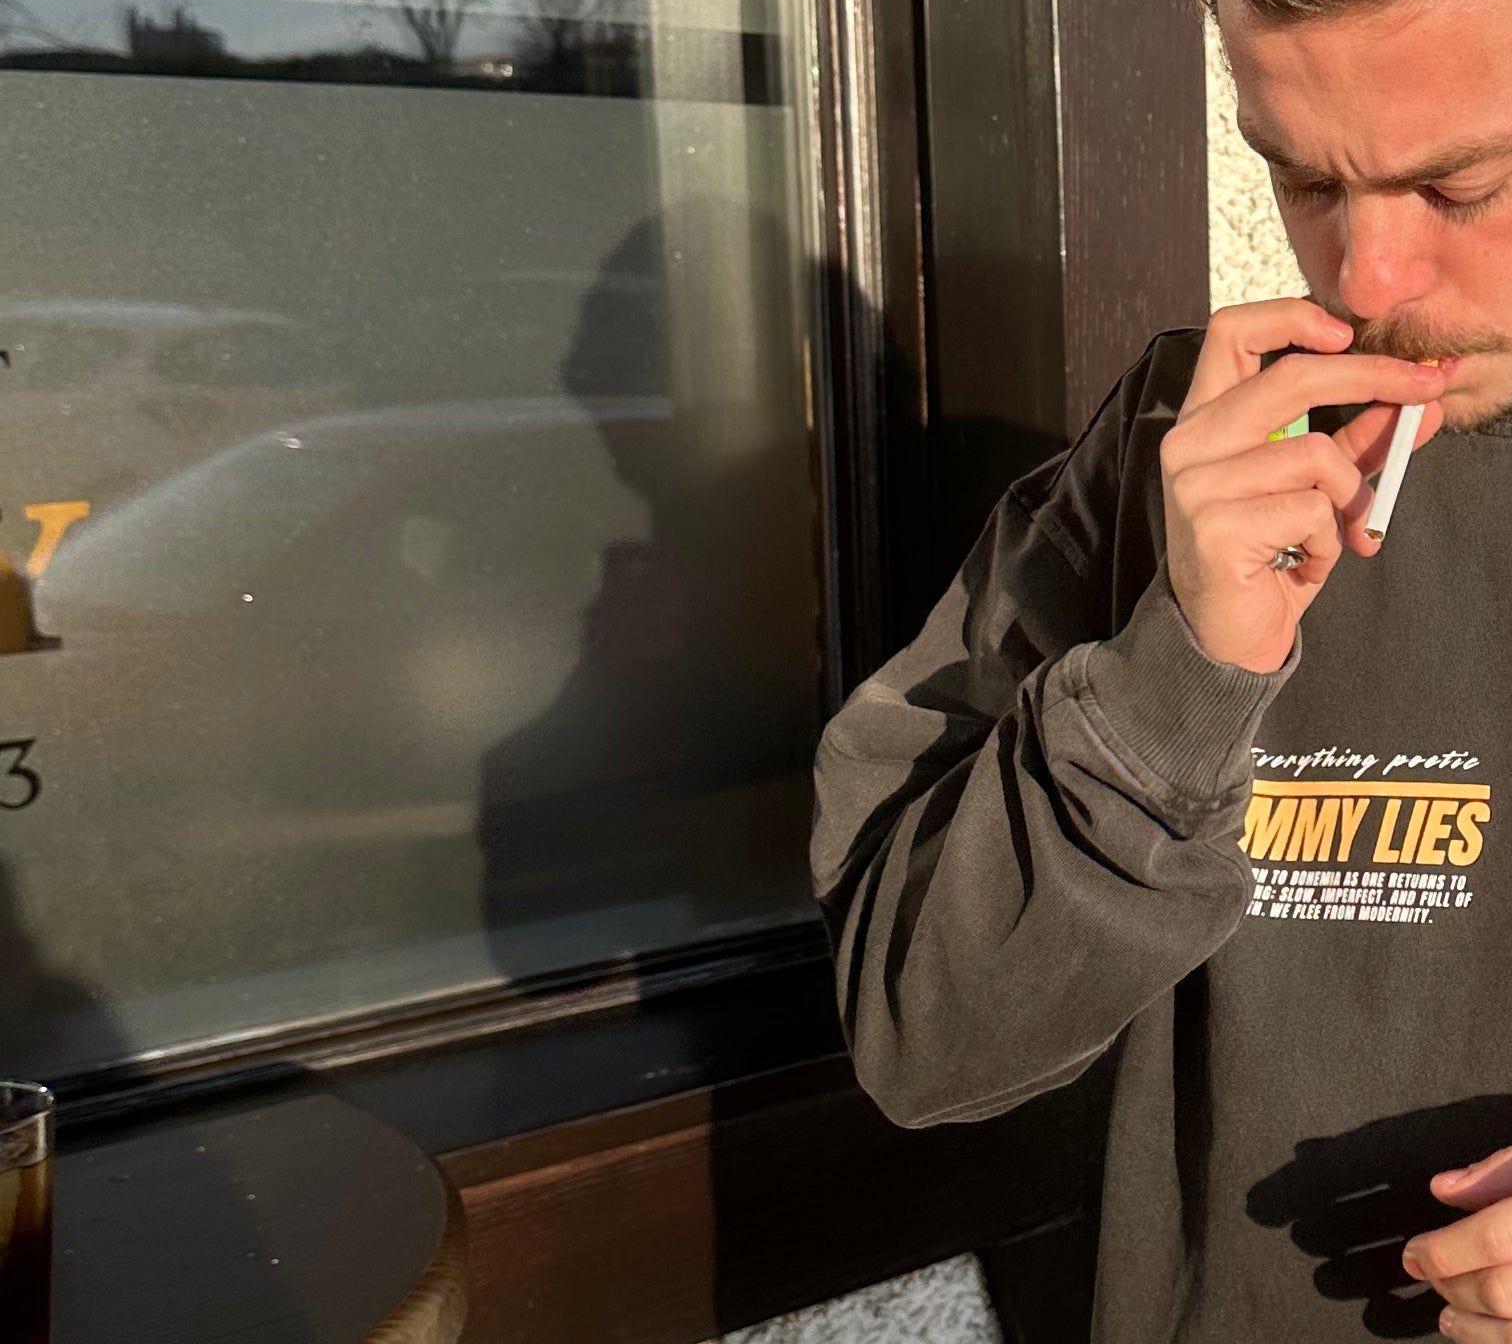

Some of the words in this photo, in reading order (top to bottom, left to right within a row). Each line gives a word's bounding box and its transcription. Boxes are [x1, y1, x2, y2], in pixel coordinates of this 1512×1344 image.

[1382, 750, 1480, 776] poetic
[1372, 798, 1491, 867] LIES
[1271, 869, 1288, 886] TO
[1289, 870, 1342, 886] BOHEMIA
[1343, 871, 1359, 887] AS
[1361, 872, 1386, 887] ONE
[1388, 872, 1446, 890] RETURNS
[1450, 875, 1467, 891] TO
[1390, 889, 1417, 906] AND
[1419, 891, 1450, 908] FULL
[1454, 892, 1473, 908] OF
[1269, 902, 1291, 919] WE
[1292, 904, 1322, 920] FLEE
[1323, 904, 1356, 920] FROM
[1358, 905, 1433, 924] MODERNITY.
